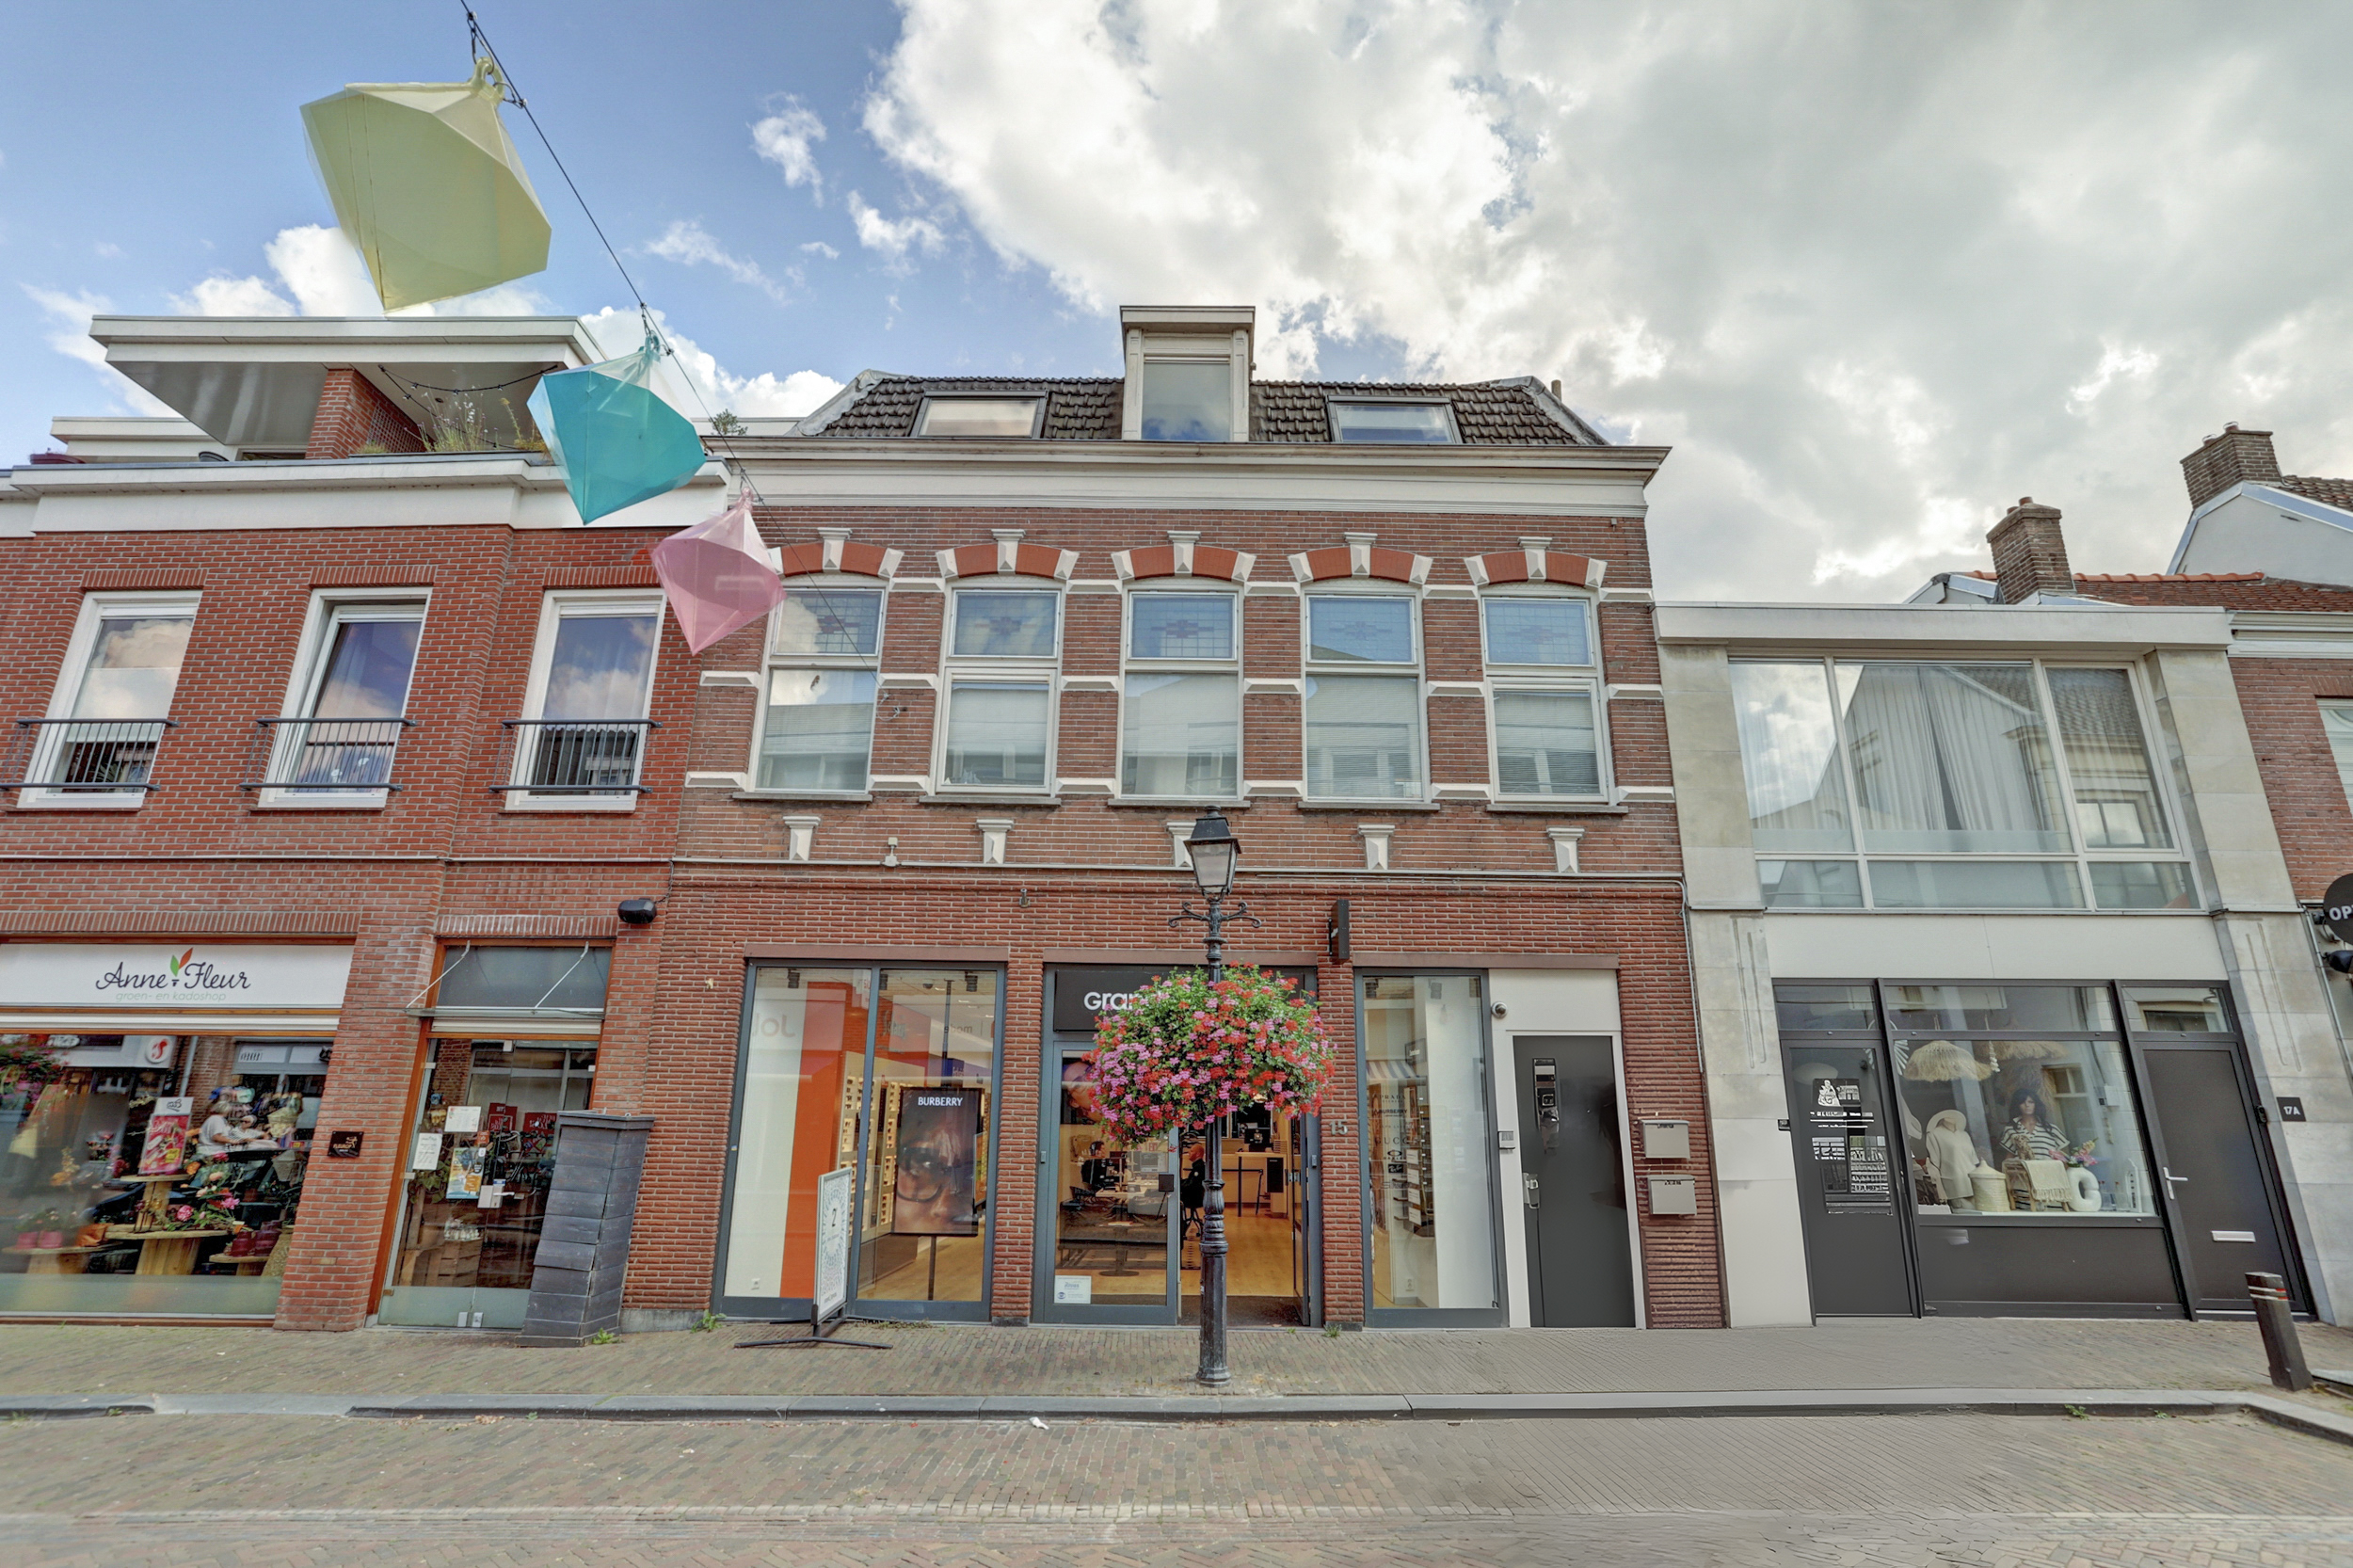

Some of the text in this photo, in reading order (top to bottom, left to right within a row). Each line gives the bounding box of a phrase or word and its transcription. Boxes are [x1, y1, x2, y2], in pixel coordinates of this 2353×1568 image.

[2329, 904, 2353, 920] OP
[96, 961, 251, 989] Anne Fleur
[116, 992, 152, 1002] groen-
[173, 991, 227, 1002] kadoshop
[918, 1096, 963, 1106] BURBERRY
[2283, 1106, 2301, 1115] 17A
[1330, 1121, 1348, 1135] 15
